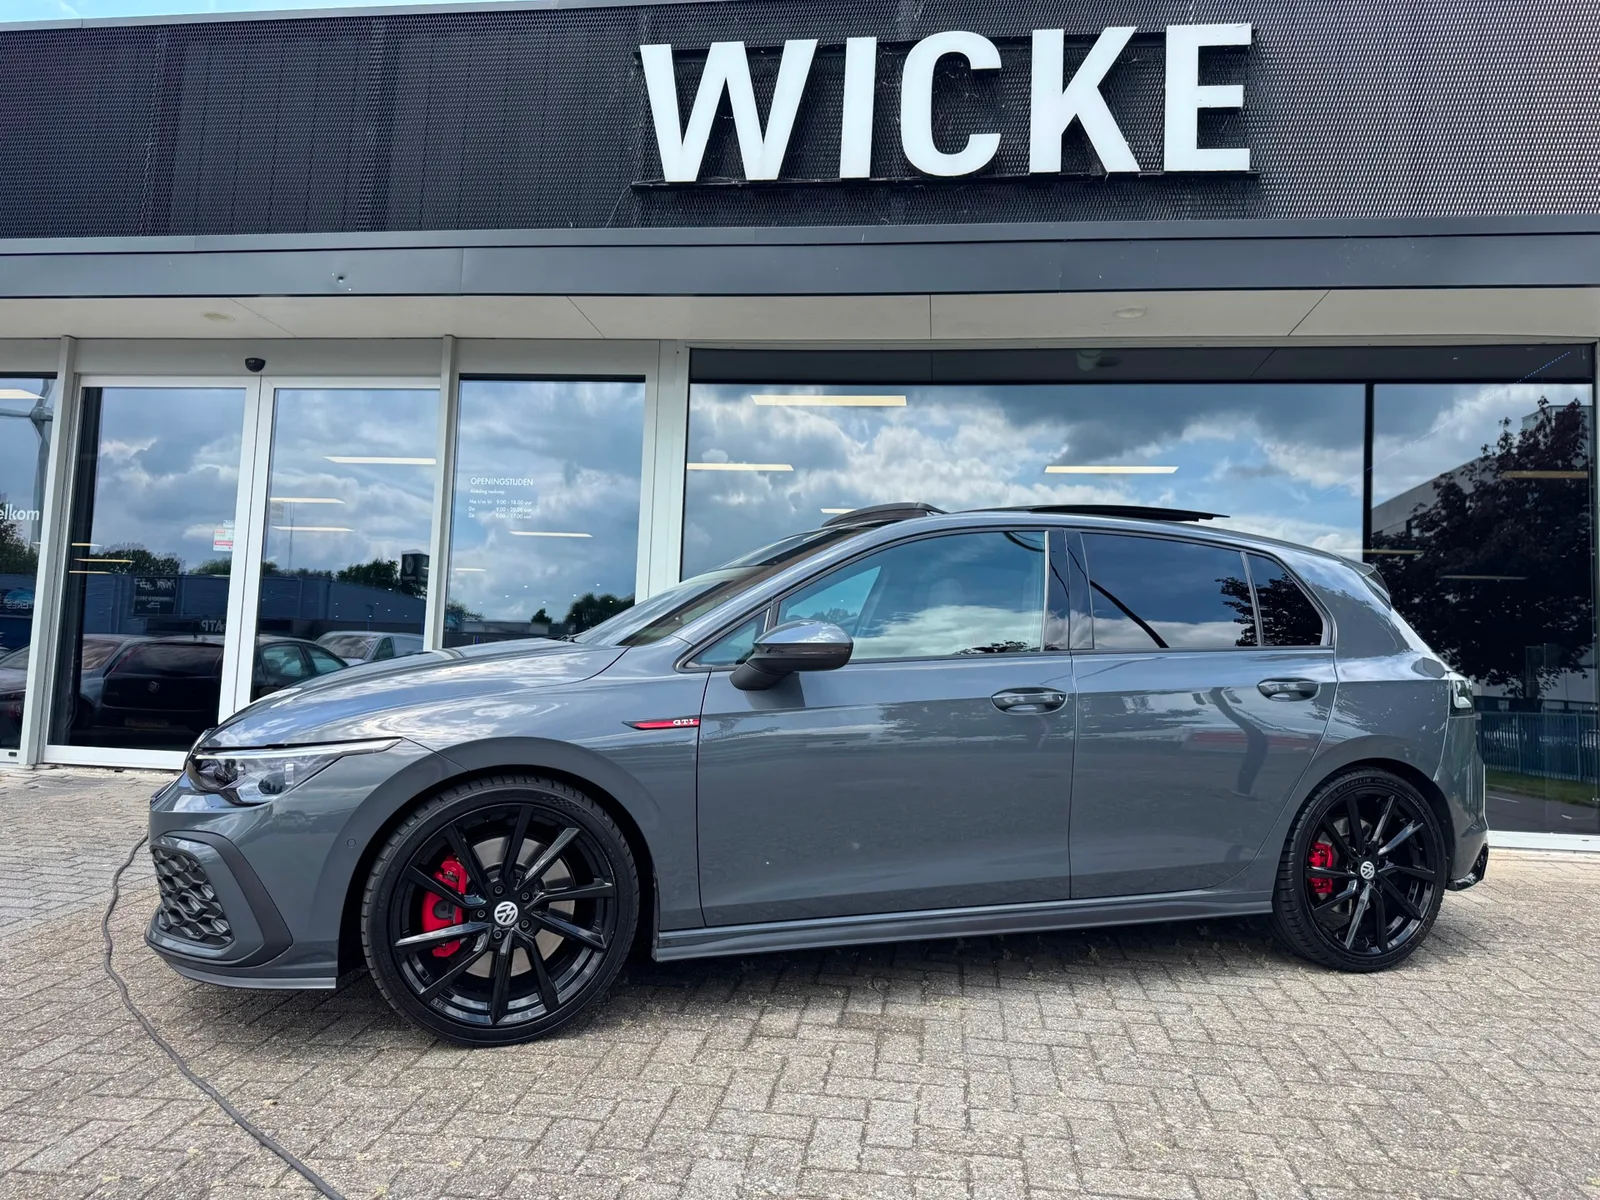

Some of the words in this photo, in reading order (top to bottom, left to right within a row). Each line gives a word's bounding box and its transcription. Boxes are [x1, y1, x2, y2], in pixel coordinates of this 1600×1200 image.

[639, 22, 1253, 183] WICKE
[470, 477, 534, 486] OPENINGSTIJDEN
[672, 718, 694, 726] GTI
